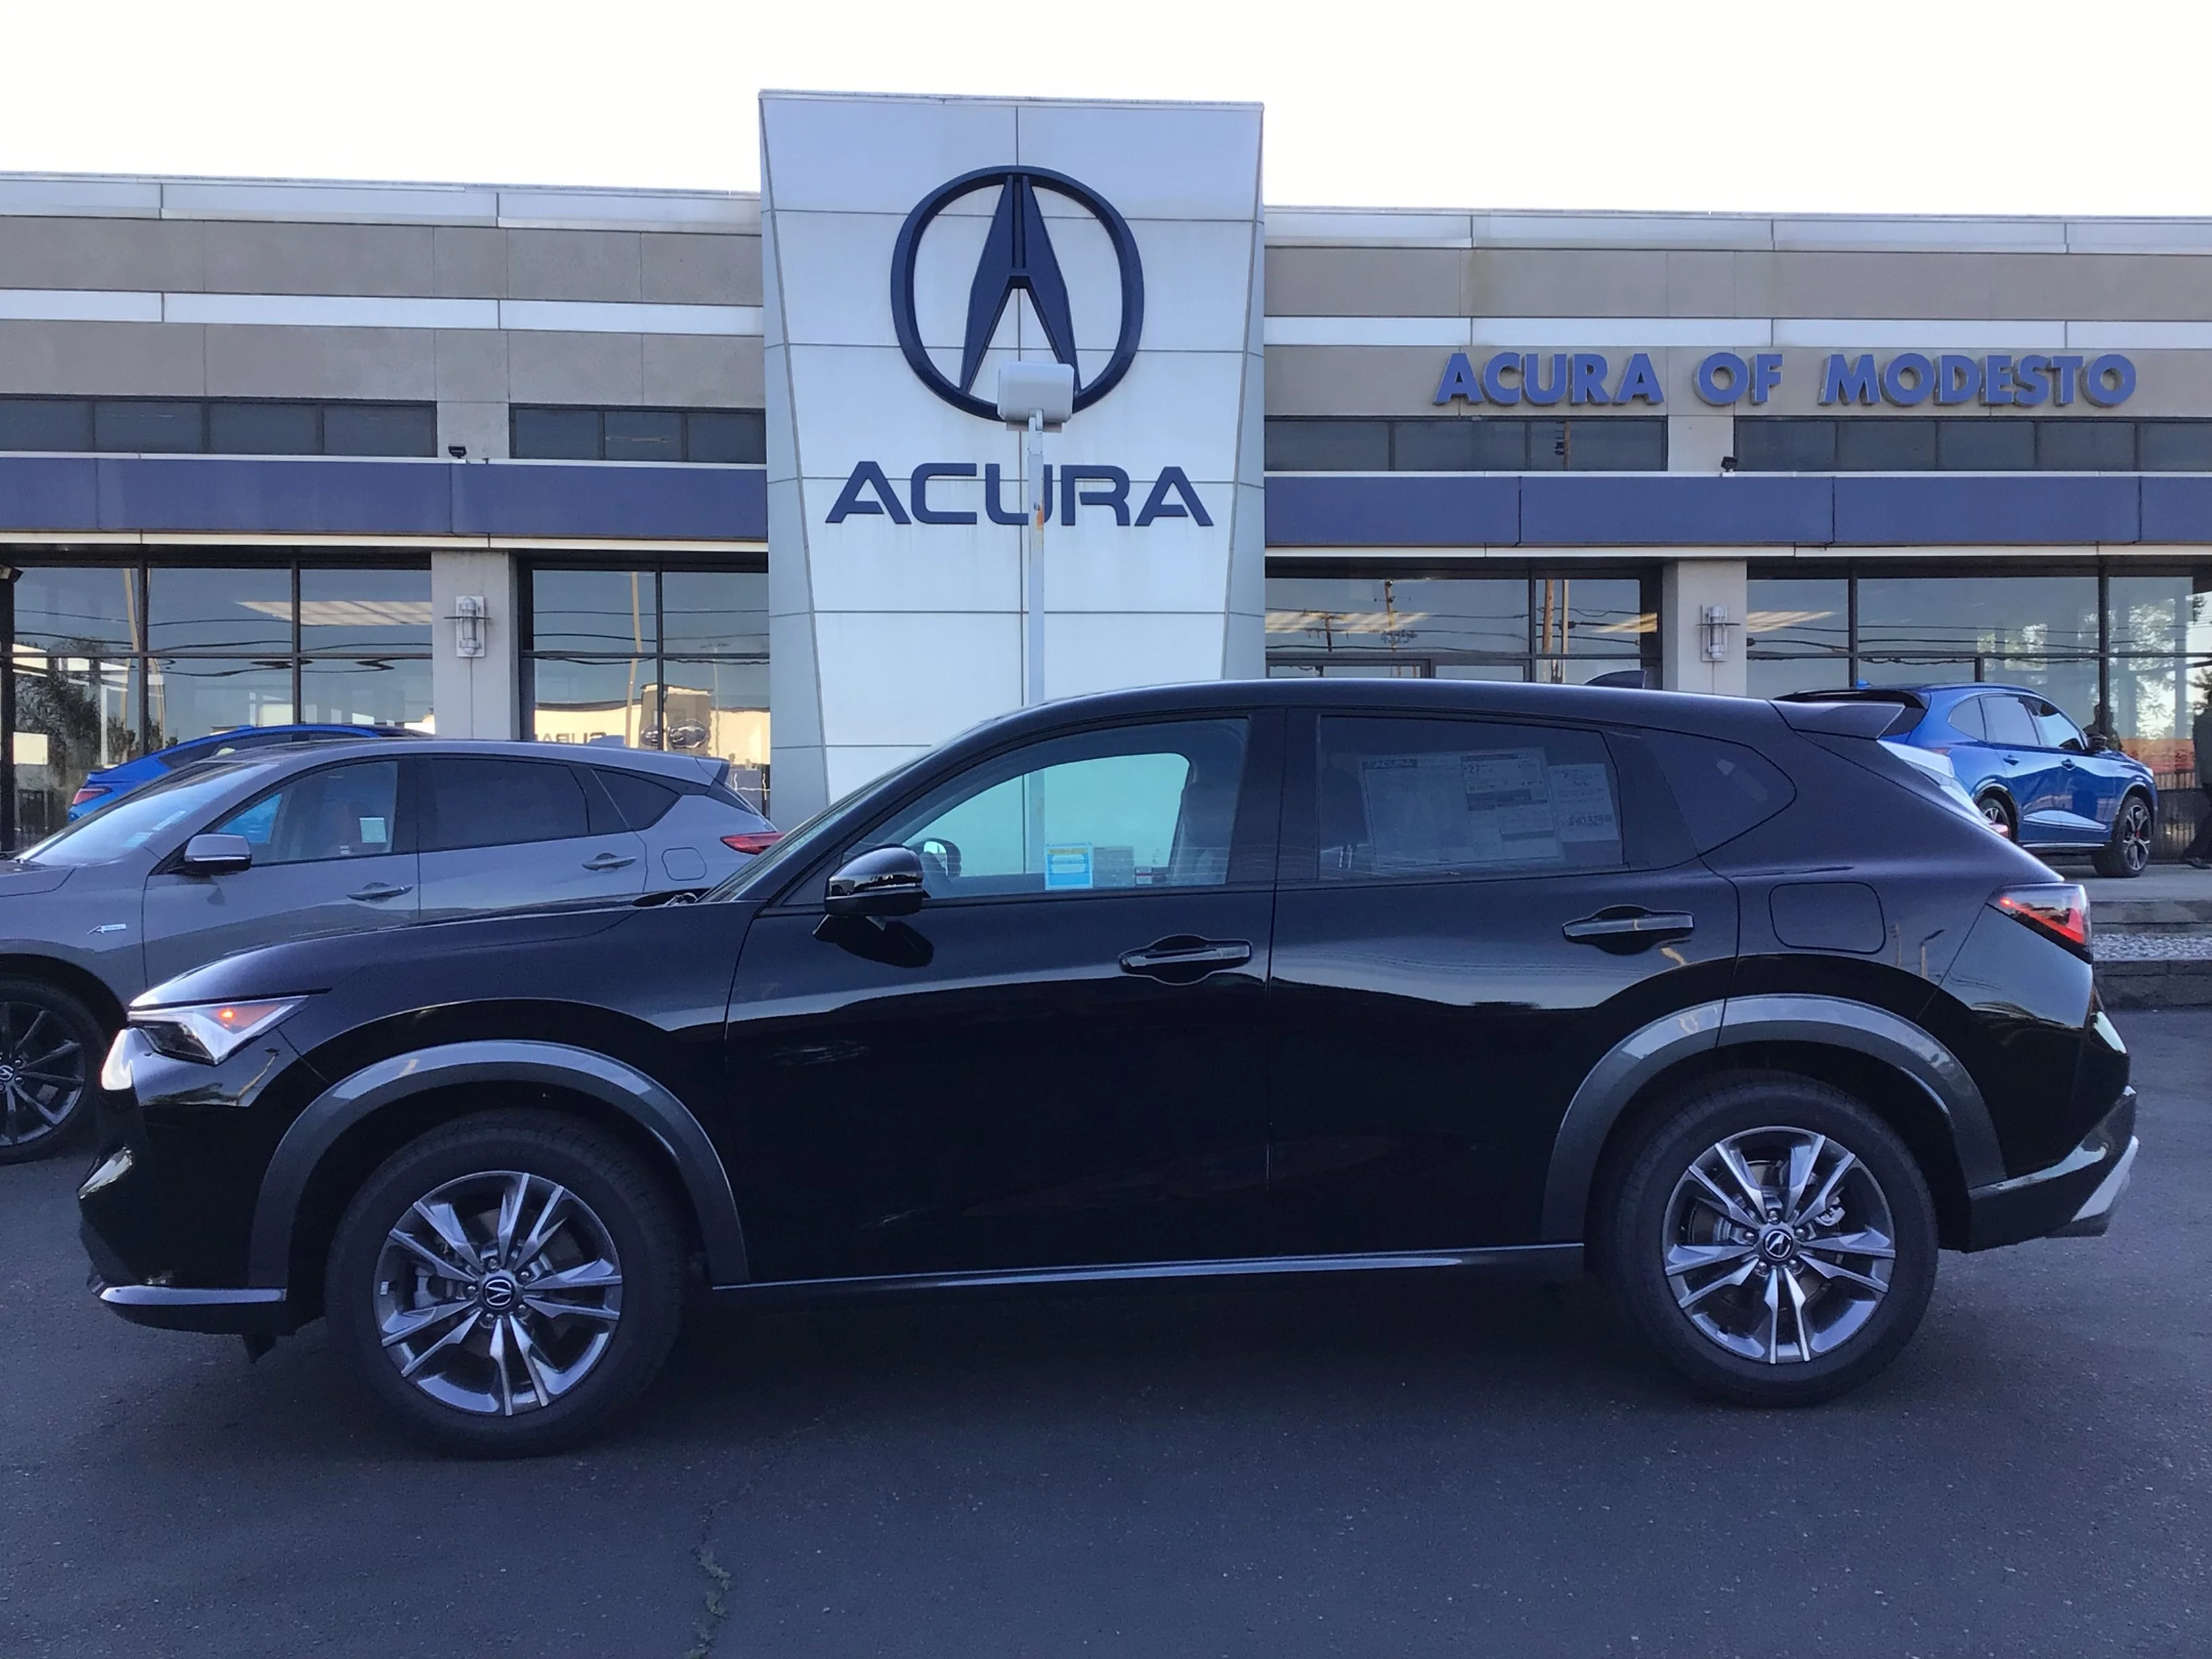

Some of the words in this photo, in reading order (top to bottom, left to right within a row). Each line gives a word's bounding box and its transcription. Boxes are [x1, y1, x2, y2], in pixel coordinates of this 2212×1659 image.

[1433, 352, 1666, 406] ACURA
[1694, 352, 1784, 406] OF
[1818, 352, 2137, 407] MODESTO
[825, 461, 1214, 527] ACURA
